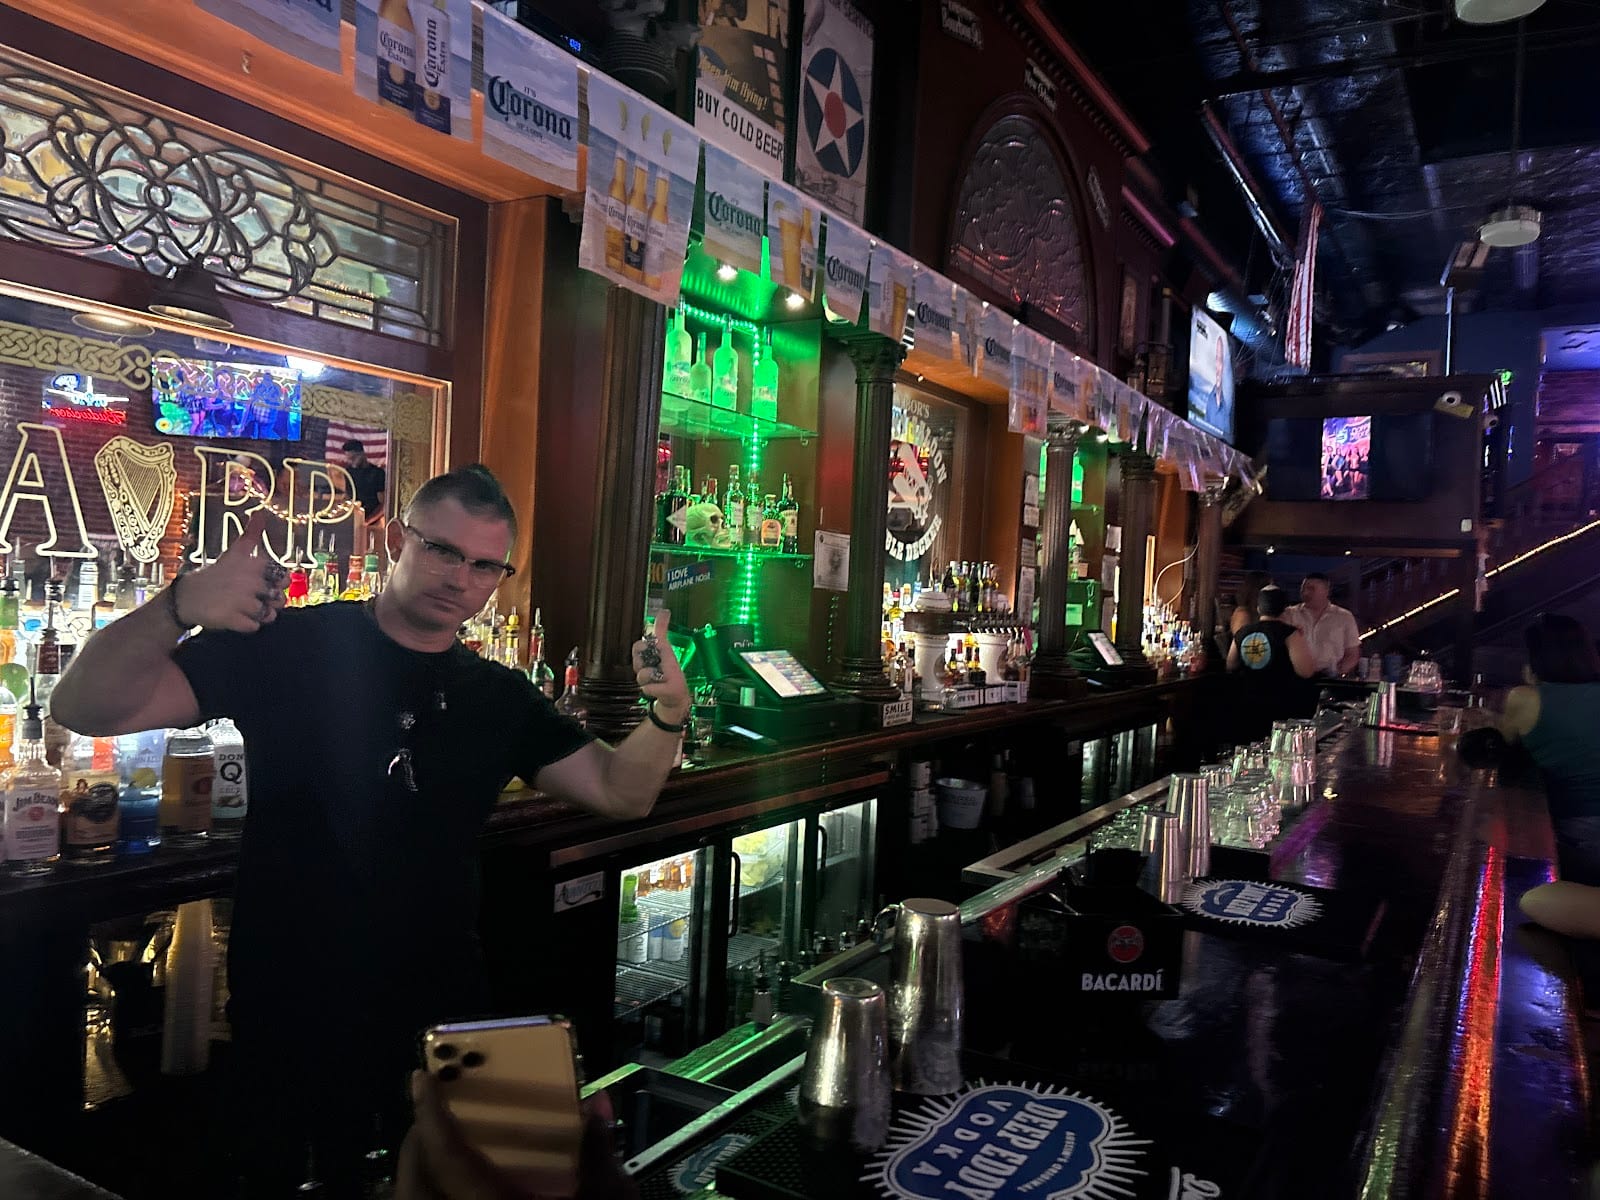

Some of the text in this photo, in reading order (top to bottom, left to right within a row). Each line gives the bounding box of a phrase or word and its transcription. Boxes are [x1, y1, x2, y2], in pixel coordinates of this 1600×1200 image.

[380, 31, 415, 57] Corona
[424, 18, 438, 88] Corona
[487, 75, 572, 140] Corona
[740, 81, 768, 112] flying!
[697, 87, 784, 163] BUY COLD BEER
[708, 191, 761, 237] Corona
[905, 513, 943, 563] DECKER
[671, 566, 689, 581] LOVE
[885, 702, 910, 715] SMILE
[220, 762, 242, 785] Q
[1081, 968, 1165, 991] BACARDÍ
[912, 1099, 1012, 1177] VODKA
[944, 1100, 1068, 1200] DEEP EDDY
